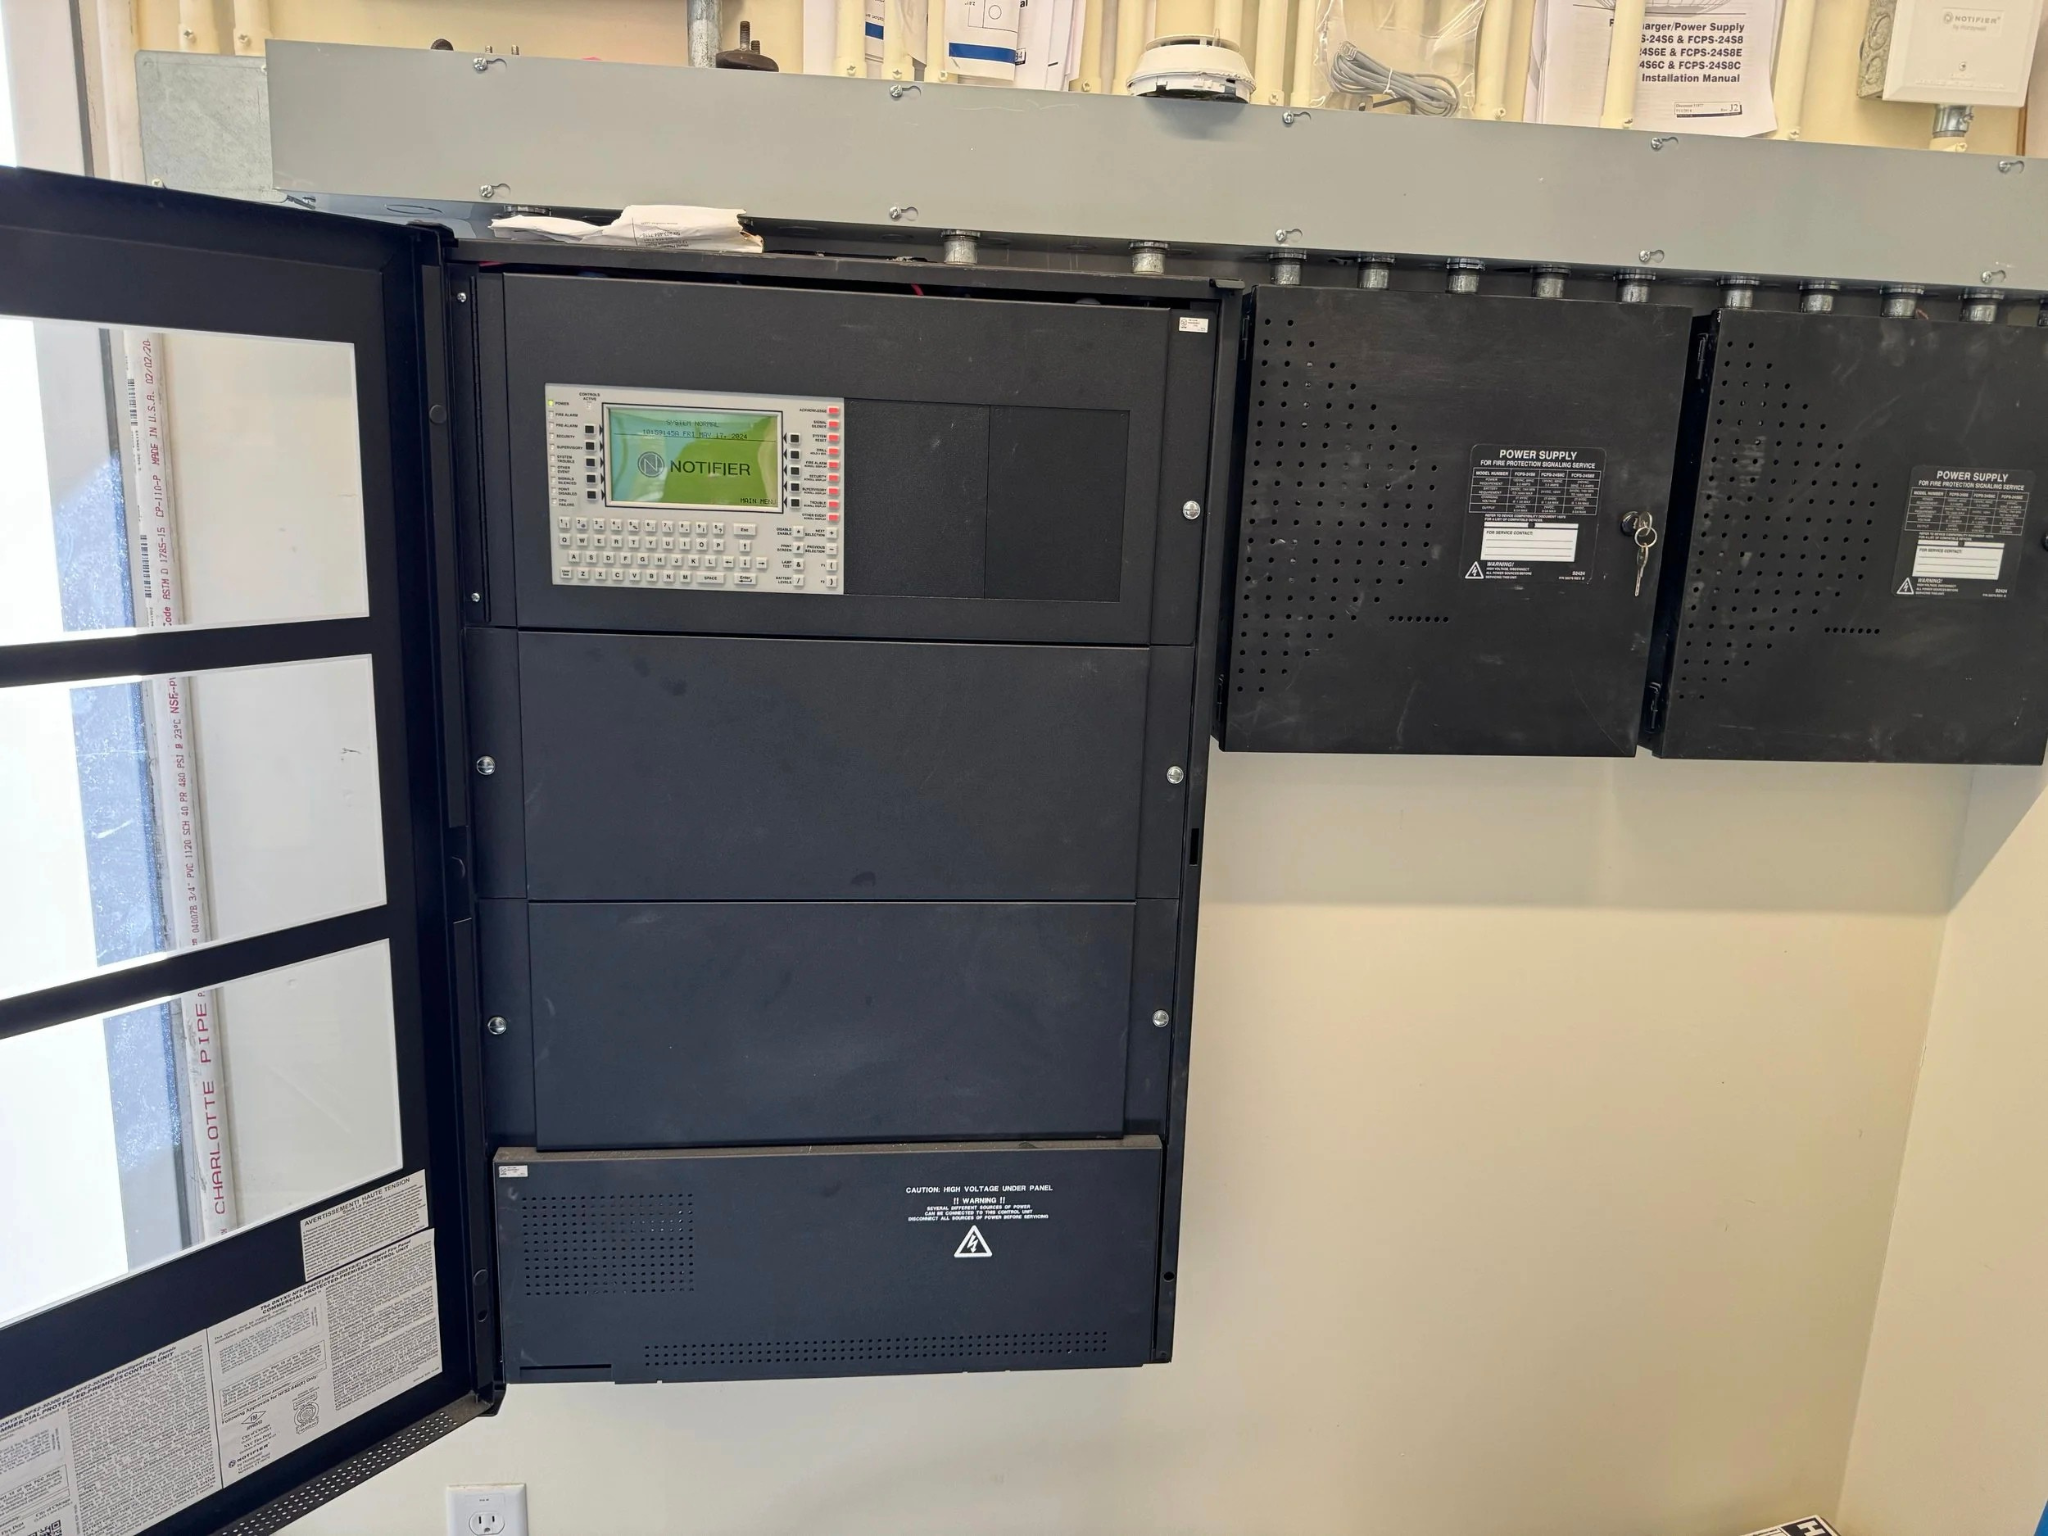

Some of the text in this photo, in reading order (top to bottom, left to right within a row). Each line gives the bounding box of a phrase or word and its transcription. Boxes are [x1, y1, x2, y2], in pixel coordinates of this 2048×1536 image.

[1710, 23, 1744, 33] Supply
[1688, 36, 1743, 44] FCPS-24S8
[1668, 61, 1675, 69] &
[1679, 61, 1741, 69] FCPS-24S8C
[1642, 74, 1740, 82] Installation Manual
[148, 391, 157, 422] U.S.A.
[149, 425, 158, 438] IN
[151, 444, 161, 466] MADE
[1500, 450, 1577, 460] POWER SUPPLY
[670, 460, 751, 476] NOTIFIER
[1937, 471, 2008, 482] POWER SUPPLY
[162, 571, 171, 600] ASTM
[180, 791, 188, 803] PR
[181, 806, 189, 817] 40
[182, 820, 190, 836] SCH
[184, 839, 192, 858] 1120
[186, 863, 194, 879] PVC
[195, 1003, 211, 1064] PIPE
[203, 1080, 226, 1215] CHARLOTTE
[362, 1189, 382, 1203] HAUTE
[385, 1178, 410, 1192] TENSION
[262, 1293, 303, 1314] COMMERCIAL
[368, 1252, 396, 1266] CONTROL
[396, 1244, 410, 1254] UNIT
[124, 1361, 157, 1378] CONTROL
[157, 1352, 174, 1364] UNIT
